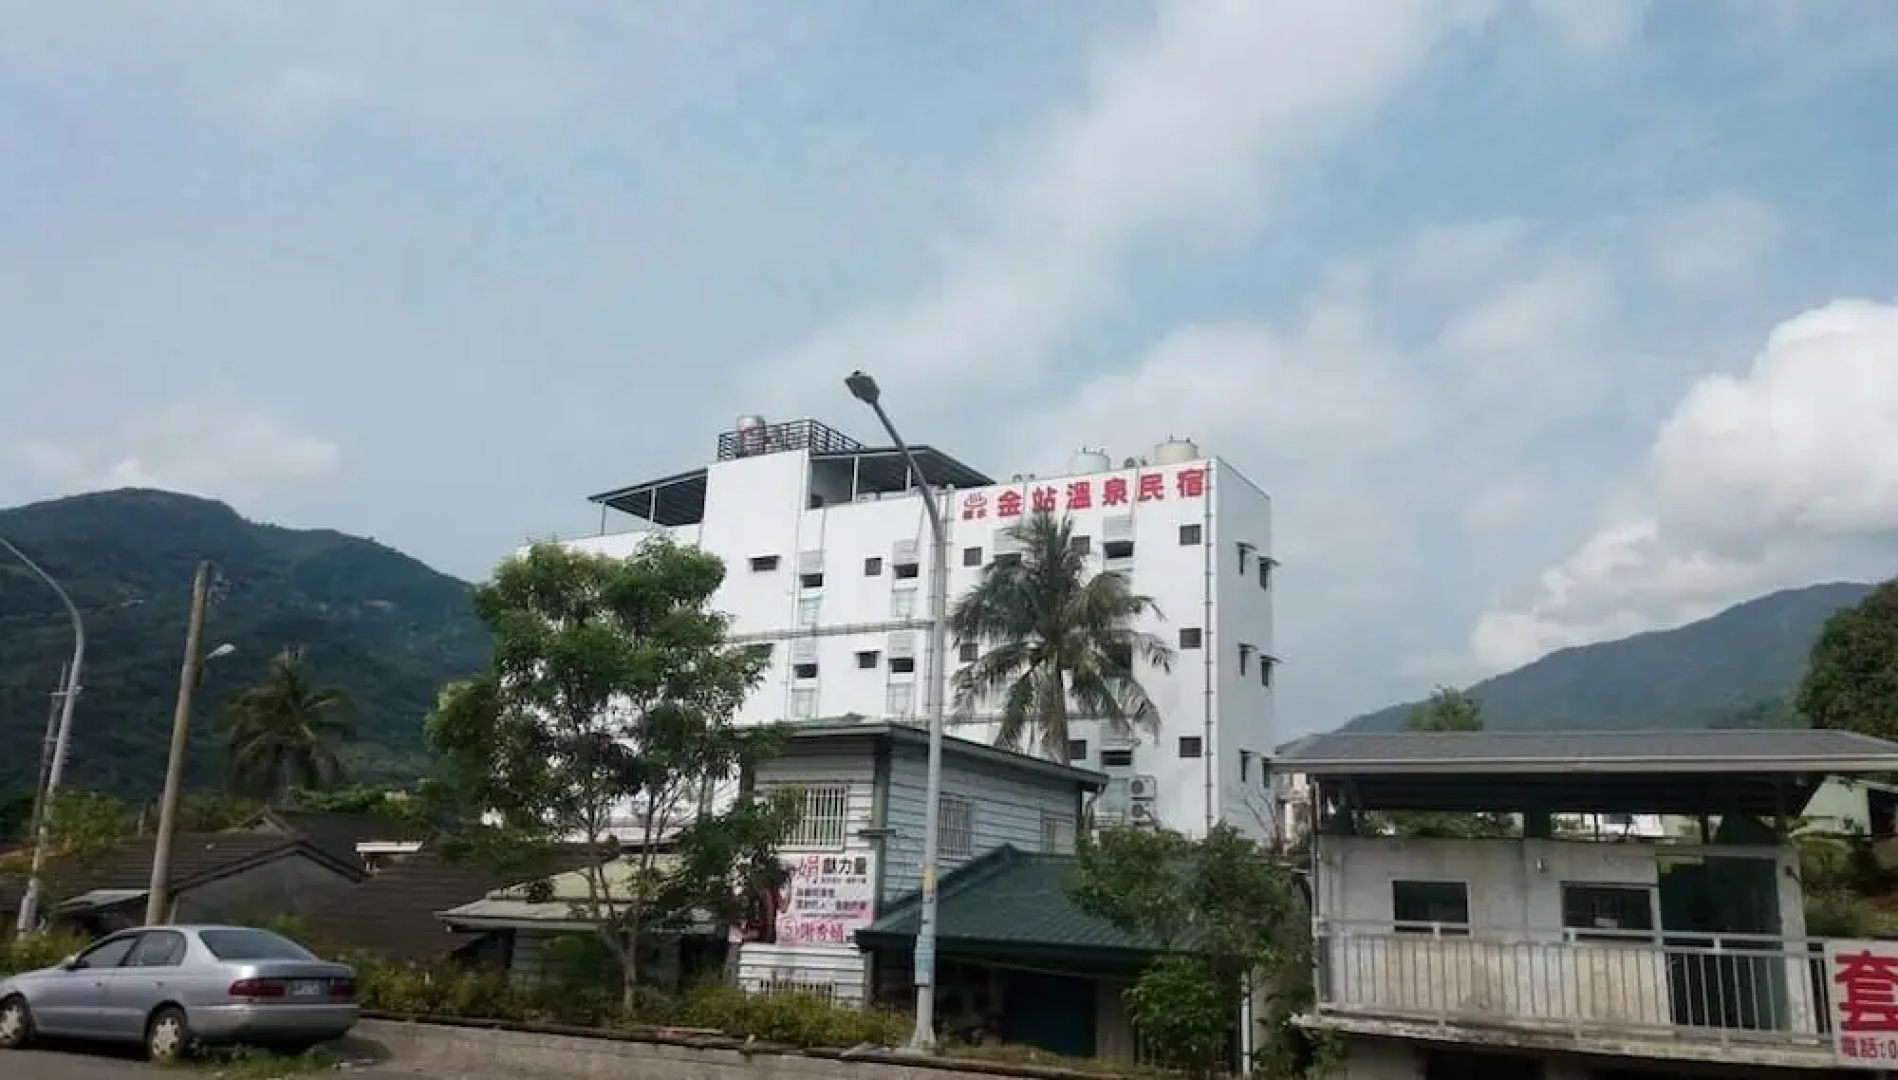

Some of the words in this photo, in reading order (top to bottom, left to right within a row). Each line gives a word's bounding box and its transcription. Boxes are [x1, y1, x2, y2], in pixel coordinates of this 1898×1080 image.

[997, 467, 1206, 518] 金站溫泉民宿
[1834, 948, 1898, 1032] 套
